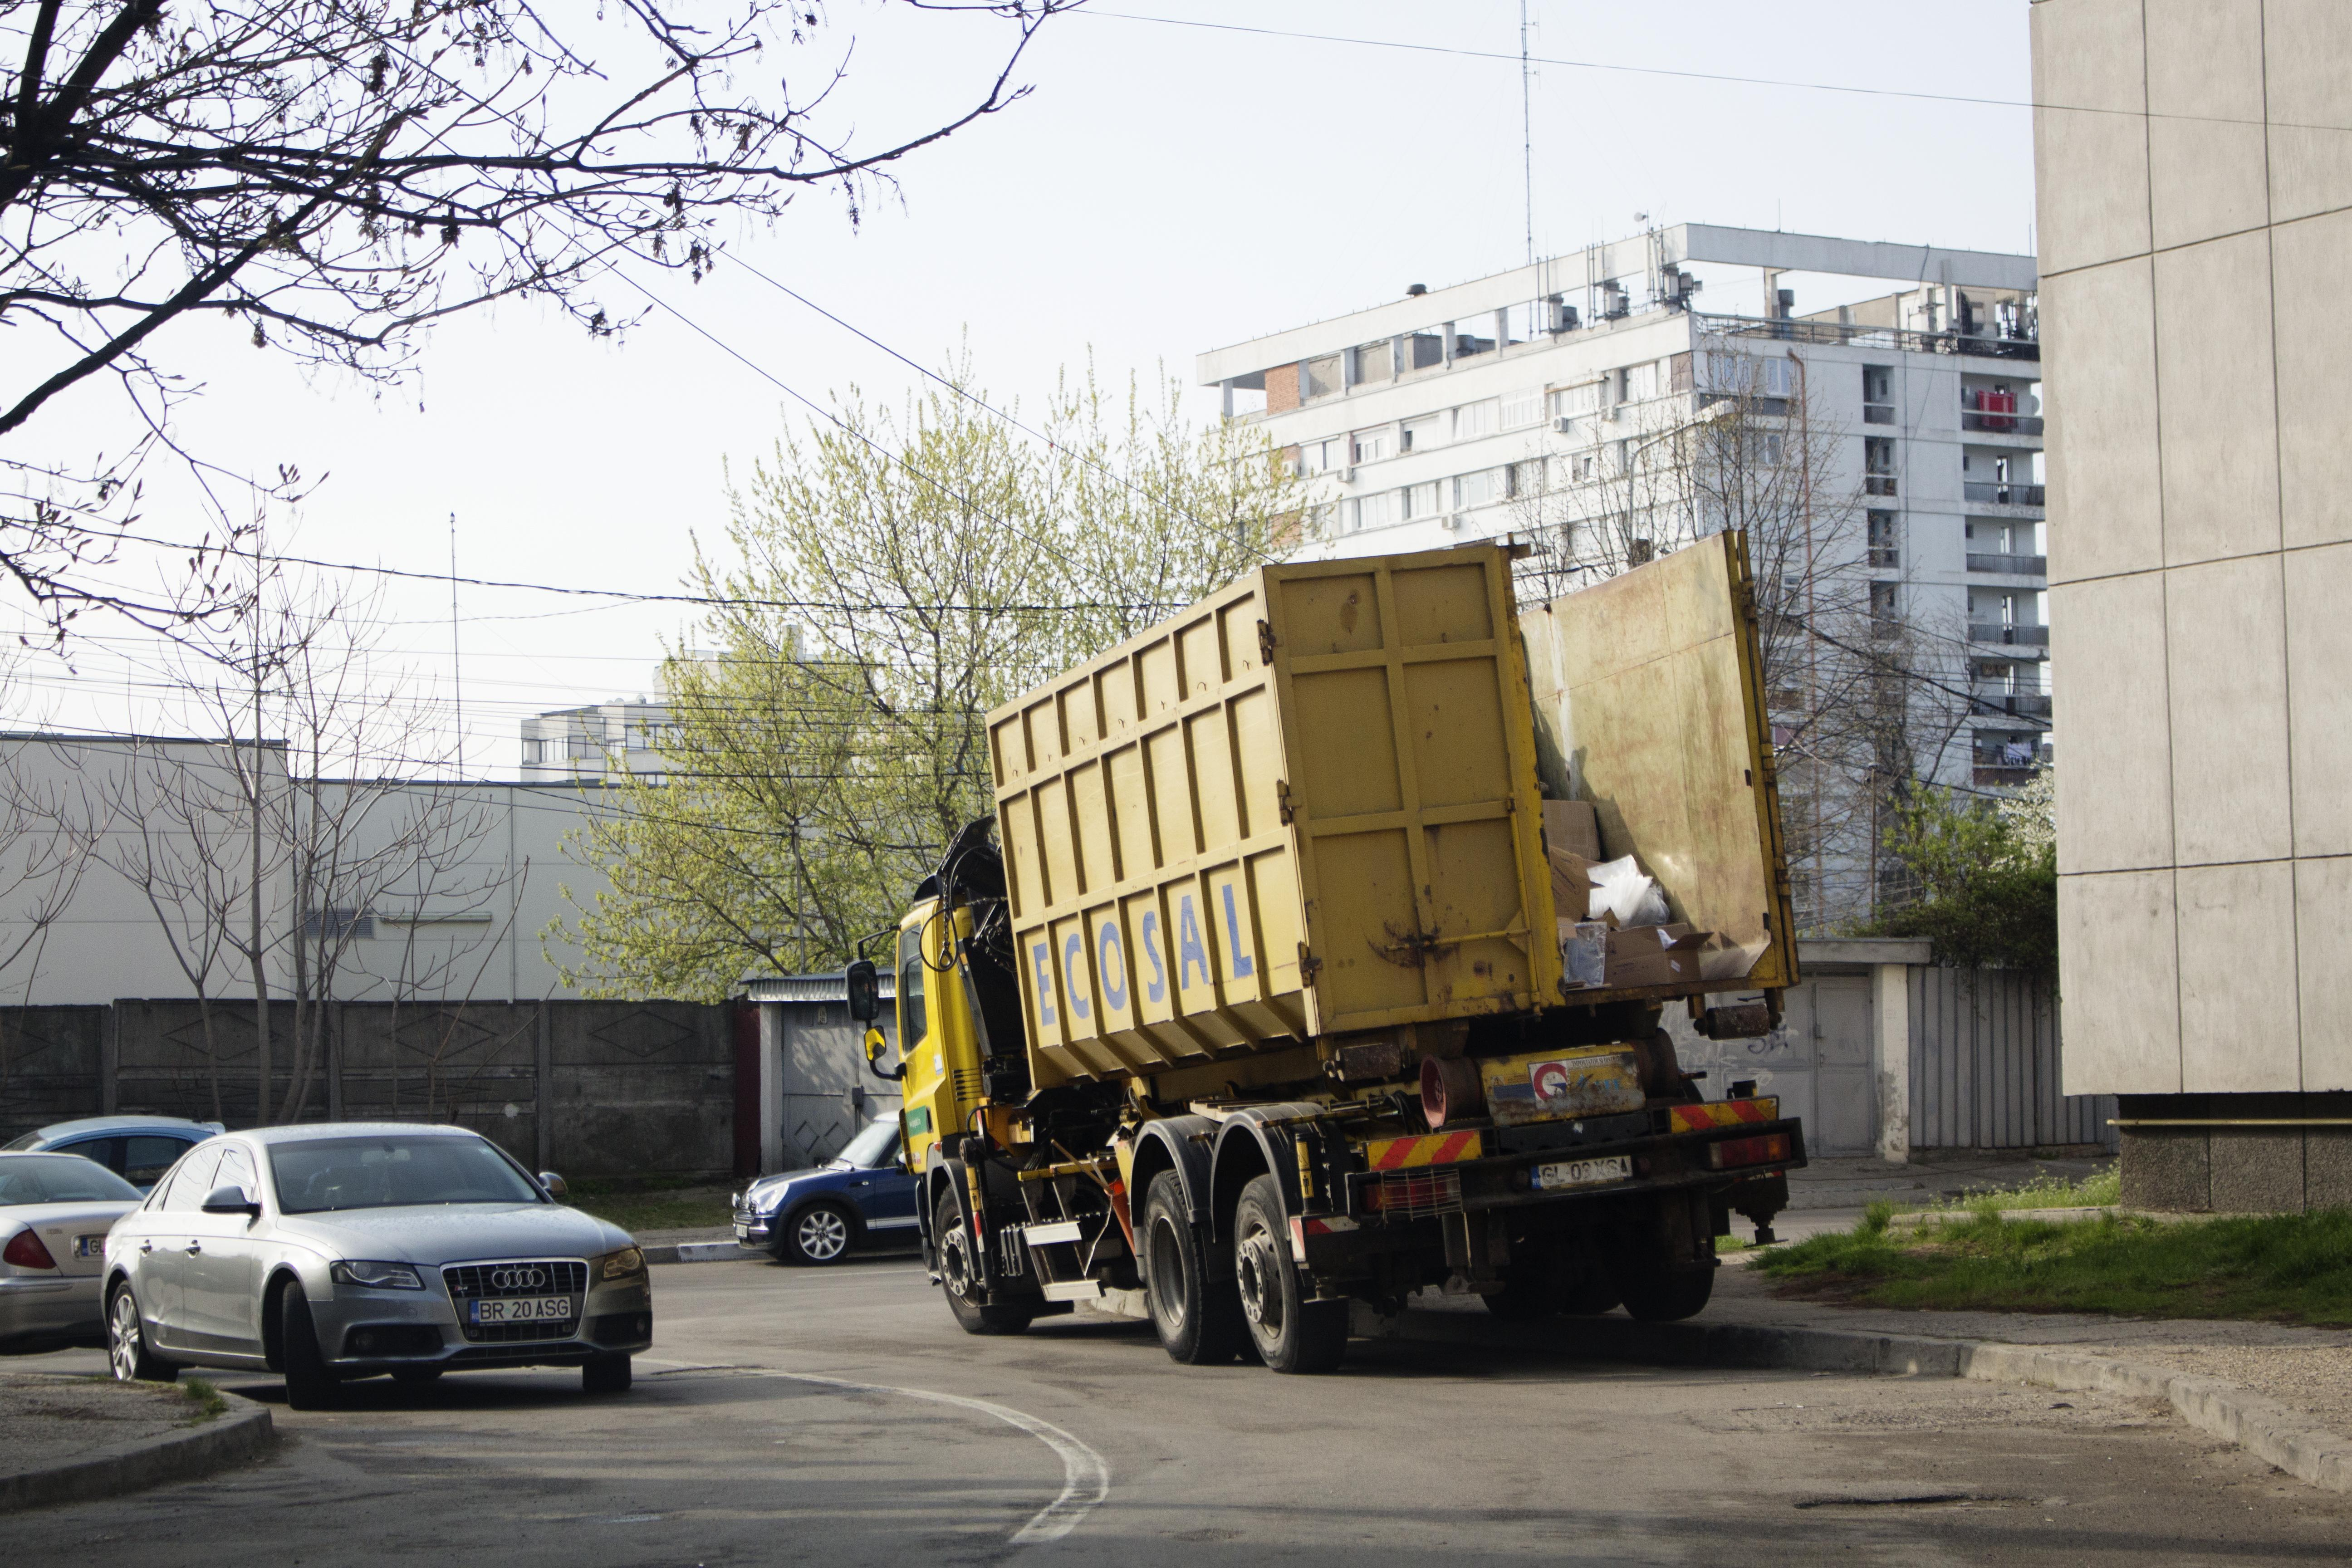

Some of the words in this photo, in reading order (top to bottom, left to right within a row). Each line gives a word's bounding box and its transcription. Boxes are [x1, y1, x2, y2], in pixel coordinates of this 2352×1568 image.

[1033, 884, 1254, 1026] ECOSAL
[1571, 1058, 1598, 1067] IMPORTATOR
[1532, 1178, 1540, 1186] RO
[90, 1240, 104, 1253] GL
[480, 1302, 504, 1320] BR
[512, 1300, 531, 1319] 20
[536, 1299, 568, 1318] ASG
